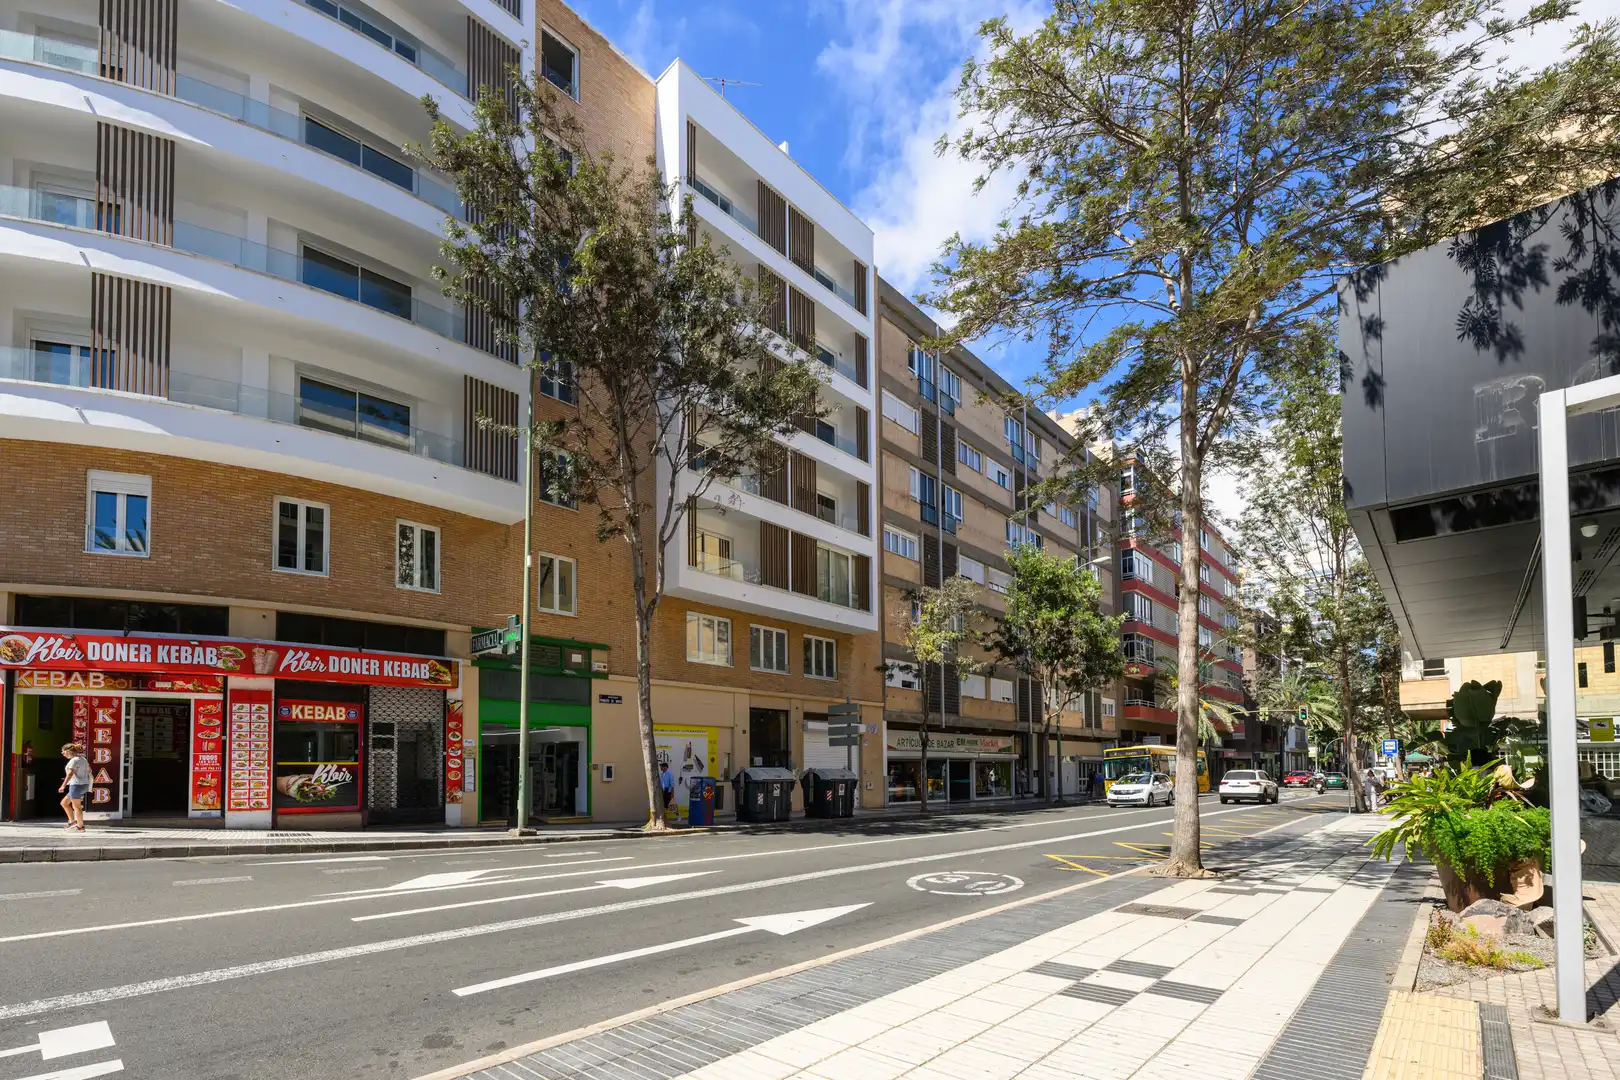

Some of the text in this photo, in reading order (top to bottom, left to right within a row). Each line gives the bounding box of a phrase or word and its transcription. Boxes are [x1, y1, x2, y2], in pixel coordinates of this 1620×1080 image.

[472, 631, 498, 652] FARMACIA
[87, 642, 152, 663] DONER
[157, 645, 218, 666] KEBAB
[329, 656, 380, 676] DONER
[383, 660, 430, 680] KEBAB
[15, 670, 105, 689] KEBAB
[291, 704, 346, 721] KEBAB
[896, 736, 923, 748] ARTÍCUL
[937, 740, 954, 749] BAZAR
[92, 708, 116, 804] KEBAB
